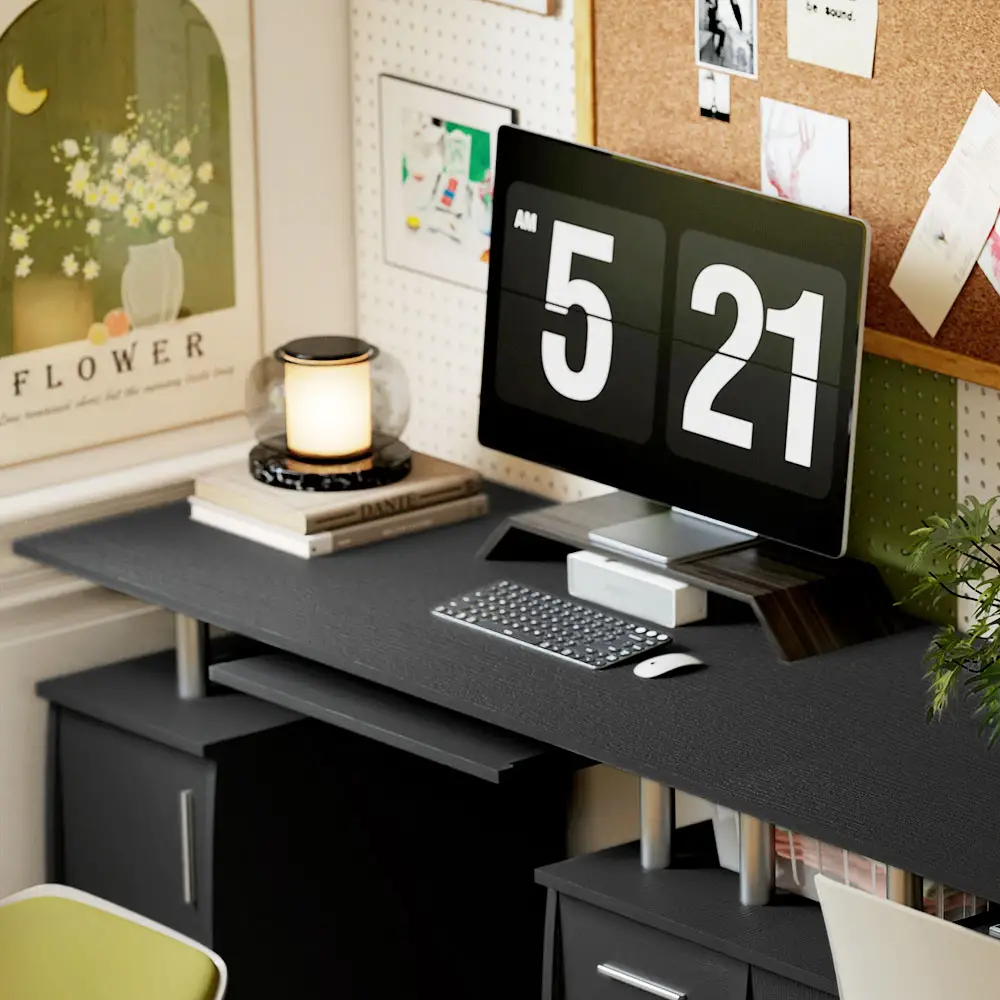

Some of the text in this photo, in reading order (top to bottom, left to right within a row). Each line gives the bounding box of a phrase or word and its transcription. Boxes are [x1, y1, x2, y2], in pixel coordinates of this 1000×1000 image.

[514, 209, 538, 233] AM
[13, 332, 204, 396] FLOWER
[541, 219, 825, 468] 5 21
